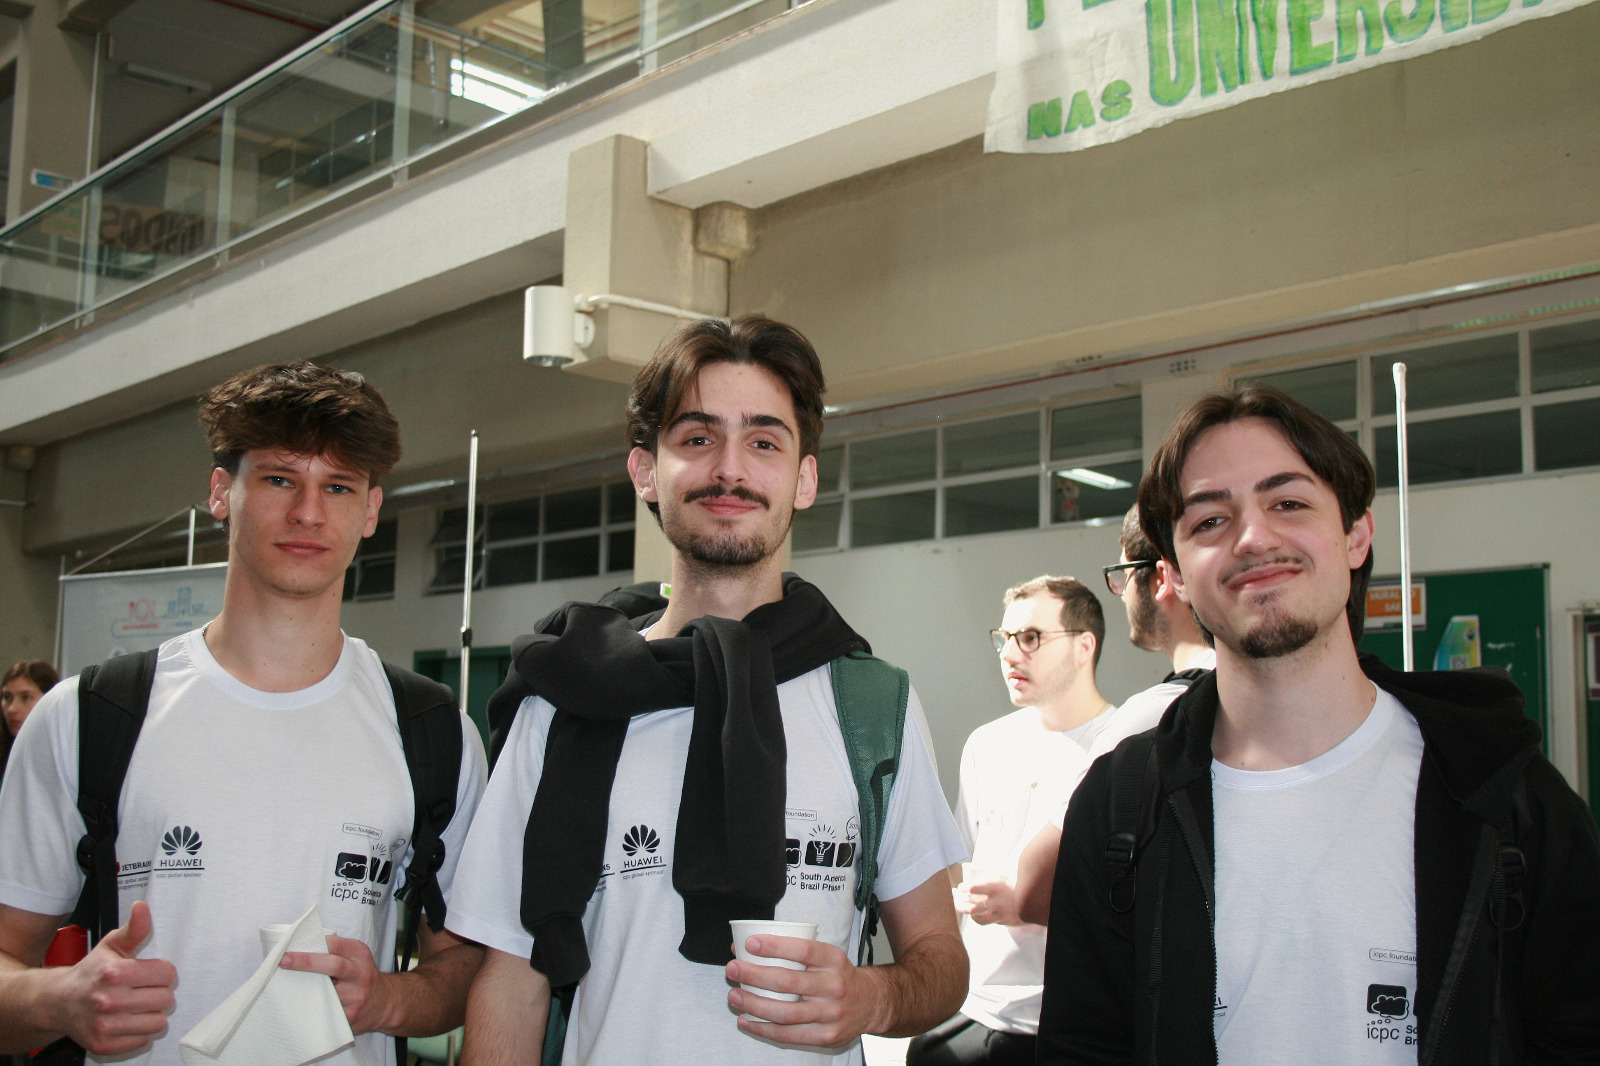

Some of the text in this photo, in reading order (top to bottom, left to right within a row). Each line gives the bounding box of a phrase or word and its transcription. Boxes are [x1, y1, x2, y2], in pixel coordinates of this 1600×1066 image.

[1027, 0, 1544, 140] NAS UNIVERS
[160, 858, 202, 867] HUAWEI
[623, 855, 663, 868] HUAWEI
[800, 872, 822, 881] South
[800, 881, 820, 890] Brazil
[331, 884, 359, 901] icpc
[1367, 1023, 1400, 1043] icpc
